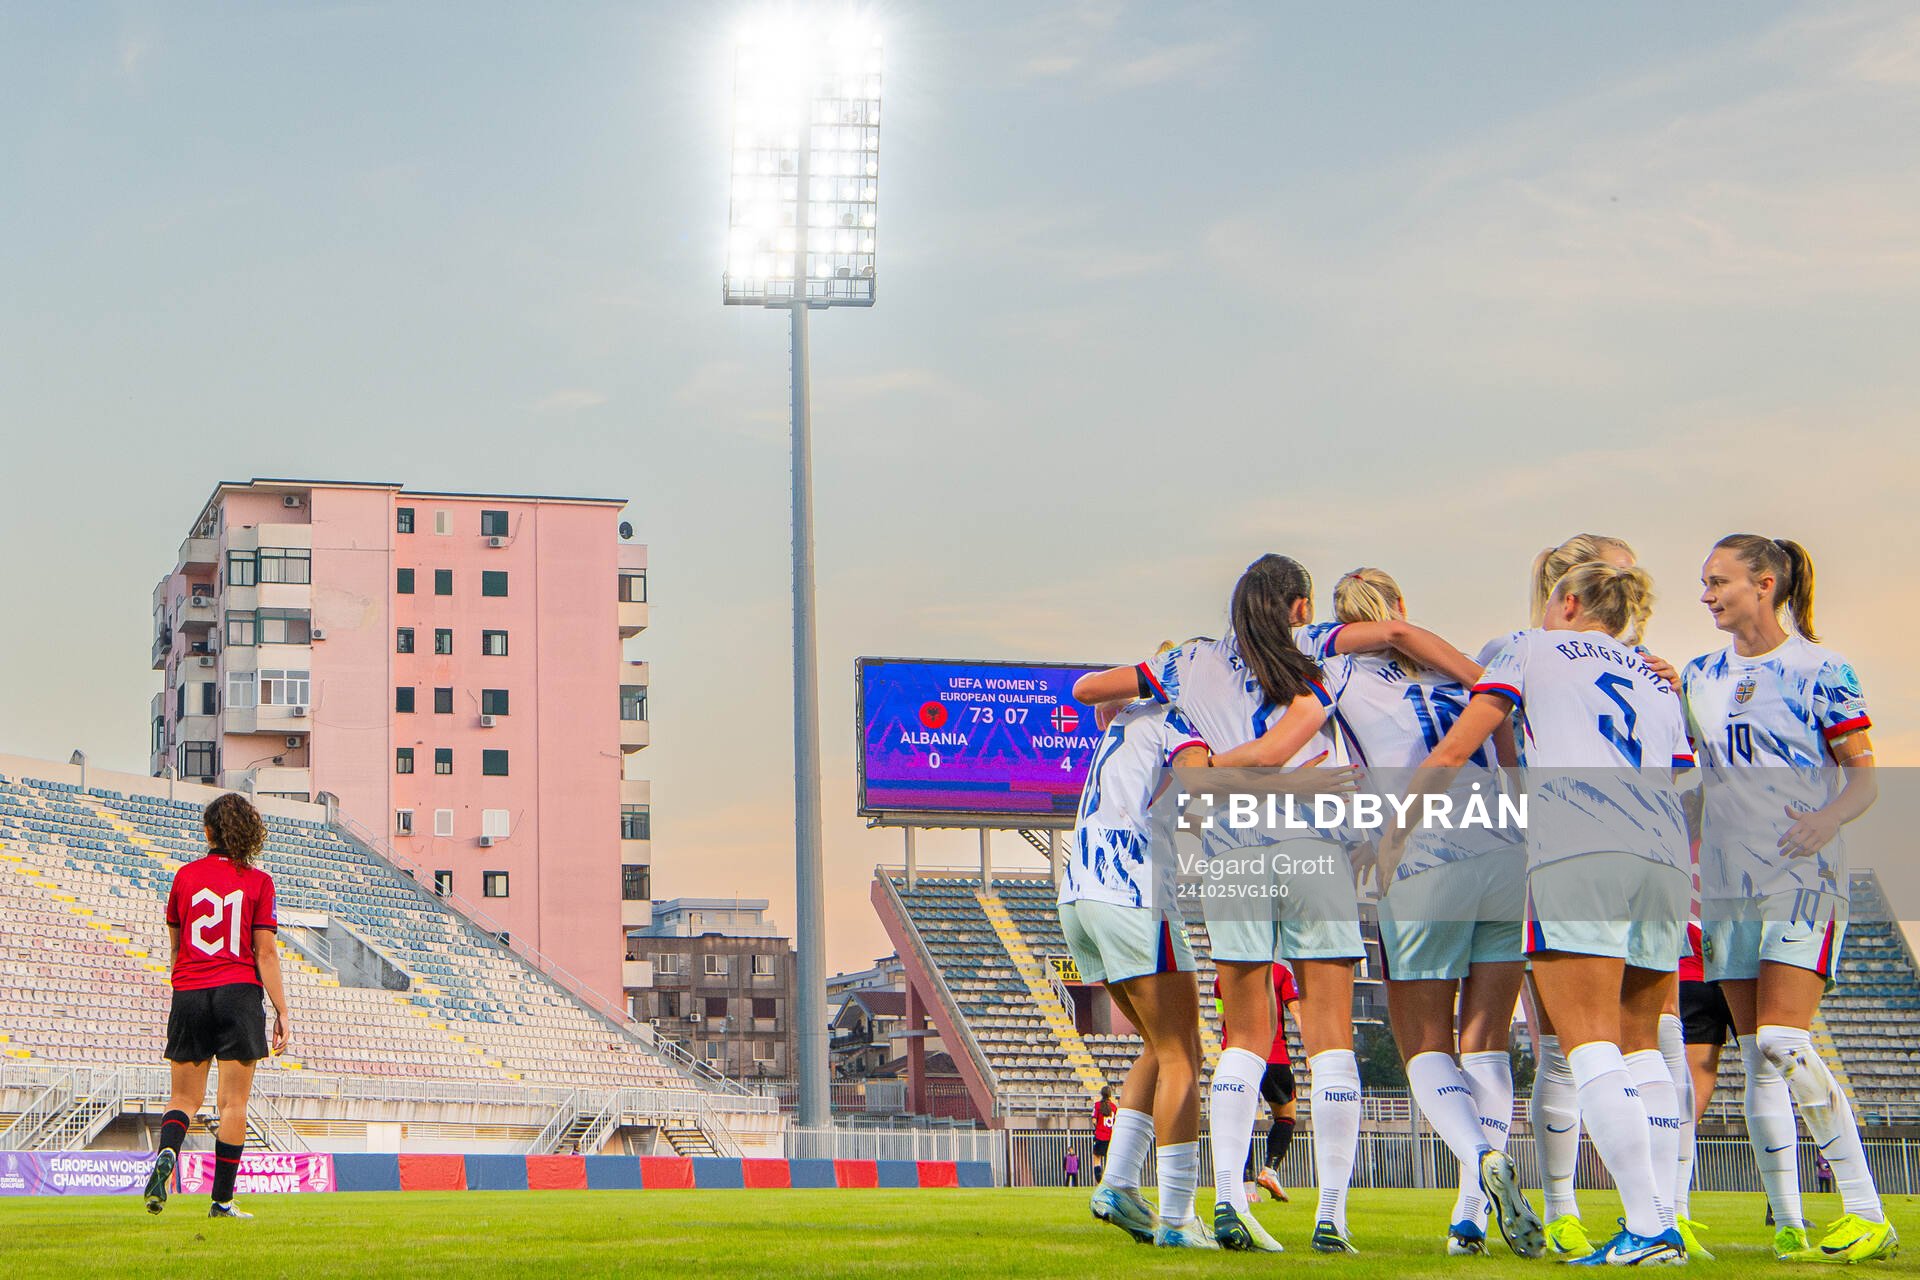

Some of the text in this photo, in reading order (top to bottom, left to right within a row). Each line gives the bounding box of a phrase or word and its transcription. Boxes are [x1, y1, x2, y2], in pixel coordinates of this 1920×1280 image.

[949, 677, 982, 689] UEFA
[940, 692, 1057, 704] EUROPEAN QUALIFIERS
[969, 707, 1029, 724] 73 07
[1594, 671, 1643, 775] 5
[900, 731, 968, 746] ALBANIA
[1032, 735, 1099, 749] NORWAY
[1725, 723, 1753, 765] 10
[928, 752, 940, 768] 0
[1060, 756, 1072, 772] 4
[1790, 888, 1820, 932] 10
[191, 887, 244, 957] 21
[1212, 1083, 1245, 1093] NORGE
[1324, 1091, 1358, 1102] NORGE
[51, 1158, 108, 1172] EUROPEAN
[53, 1173, 132, 1187] CHAMPIONSHIP
